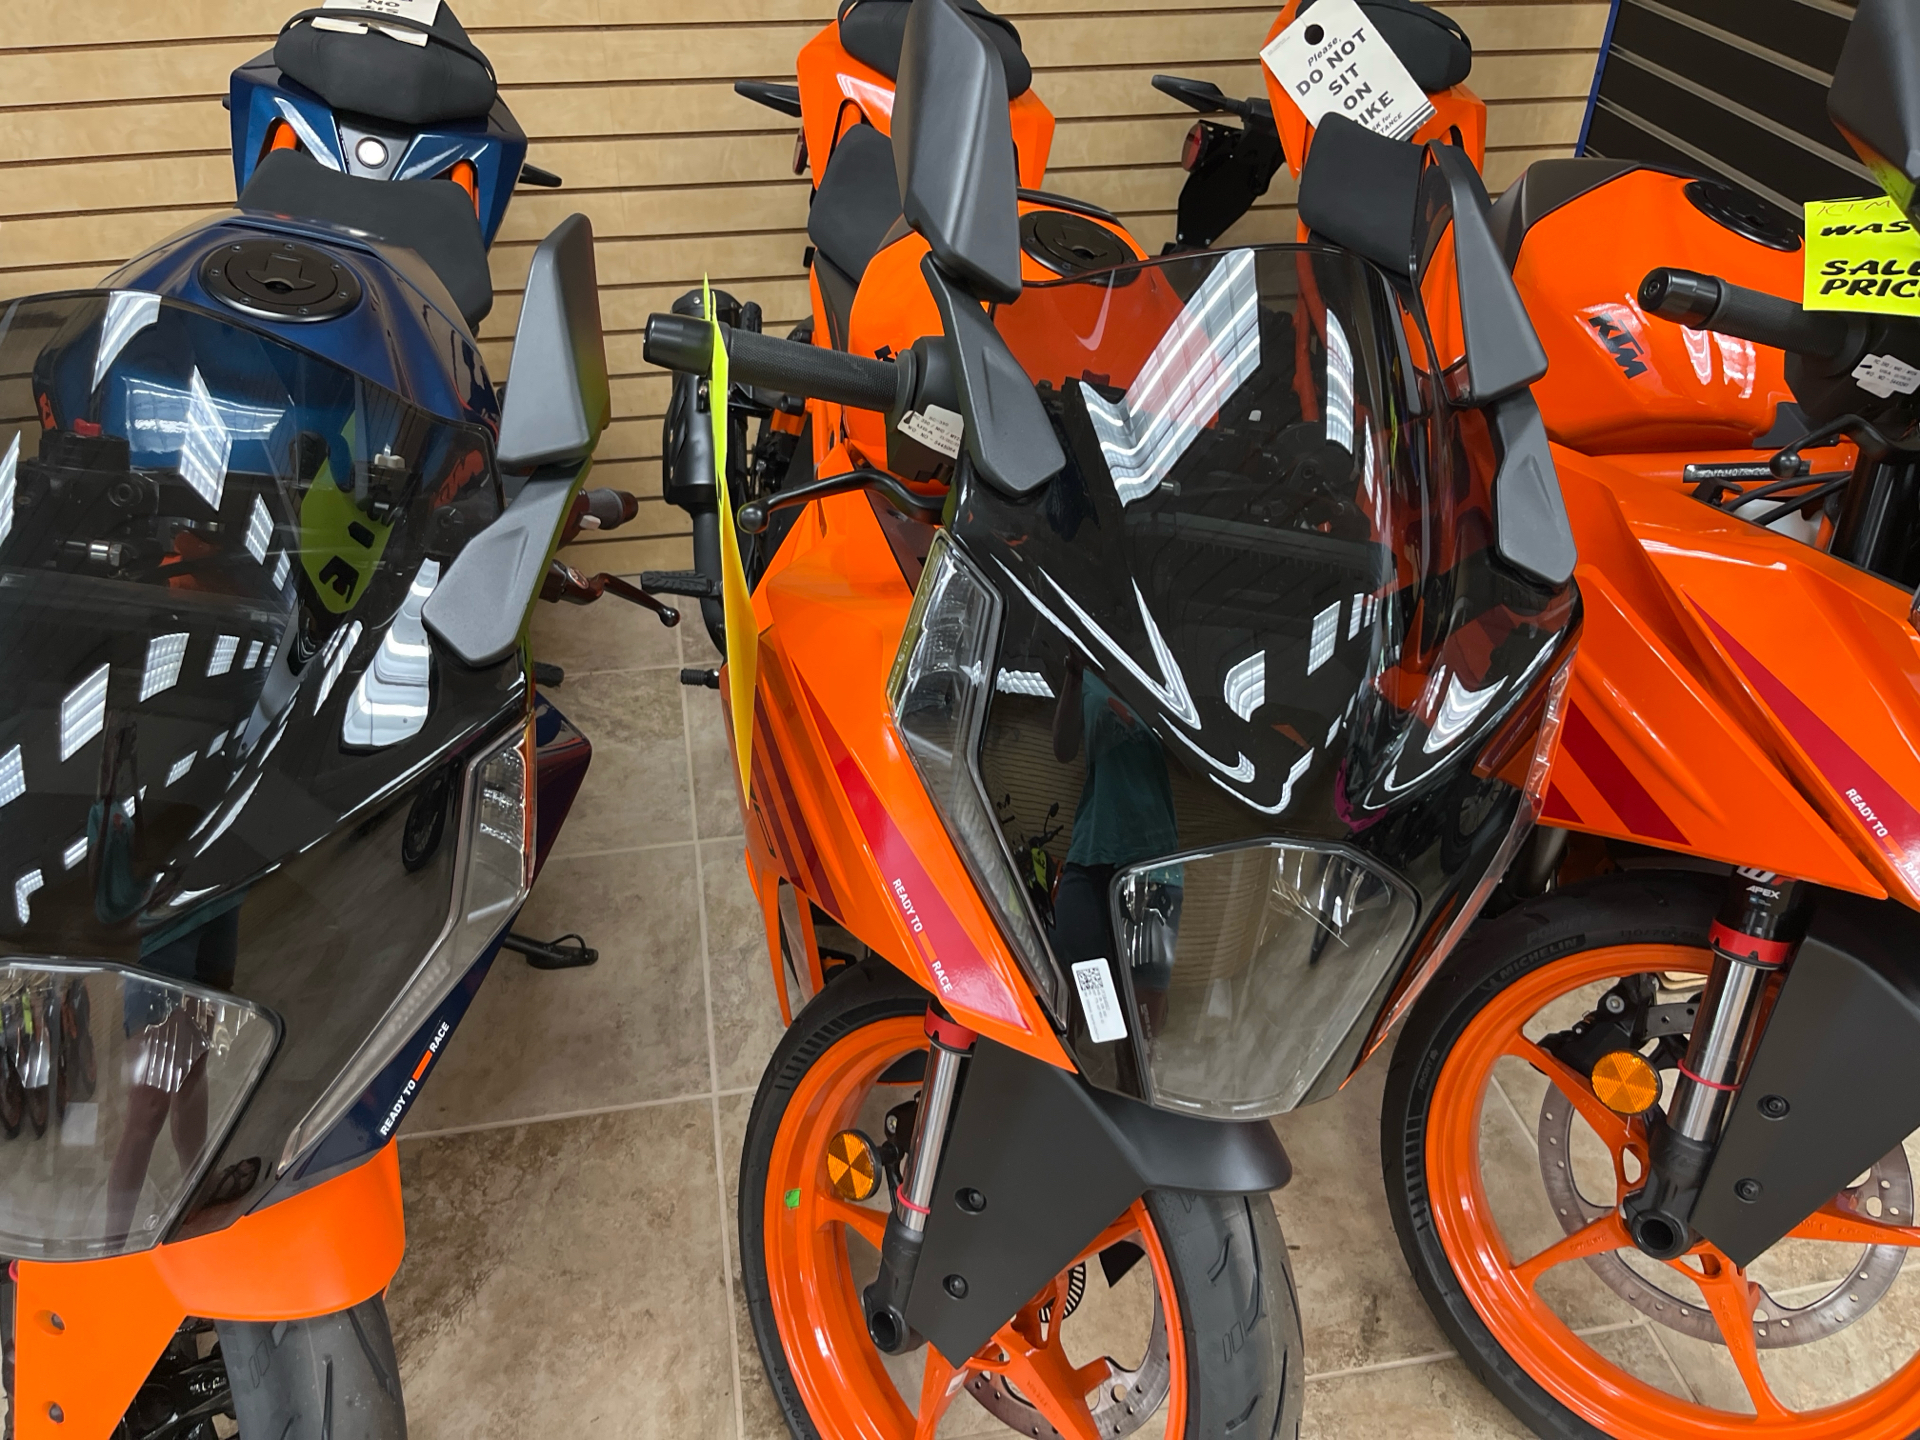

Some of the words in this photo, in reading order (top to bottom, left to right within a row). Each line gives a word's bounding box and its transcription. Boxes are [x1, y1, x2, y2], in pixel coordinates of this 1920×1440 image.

[1295, 68, 1324, 97] DO
[1326, 27, 1368, 70] NOT
[1306, 36, 1343, 67] Please,
[1328, 62, 1360, 96] SIT
[1343, 81, 1373, 111] ON
[1352, 90, 1395, 127] IKE
[1819, 220, 1912, 237] WAS
[1819, 278, 1920, 298] PRIC
[1588, 312, 1650, 380] KTM
[1845, 787, 1877, 822] READY
[1872, 820, 1888, 838] TO
[1903, 861, 1920, 889] RAC
[1745, 885, 1781, 900] APEX
[892, 878, 916, 917] READY
[910, 914, 923, 932] TO
[931, 960, 954, 993] RACE
[1499, 937, 1578, 979] MICHELIN
[379, 1094, 407, 1137] READY
[402, 1079, 417, 1096] TO
[428, 1021, 450, 1053] RACE
